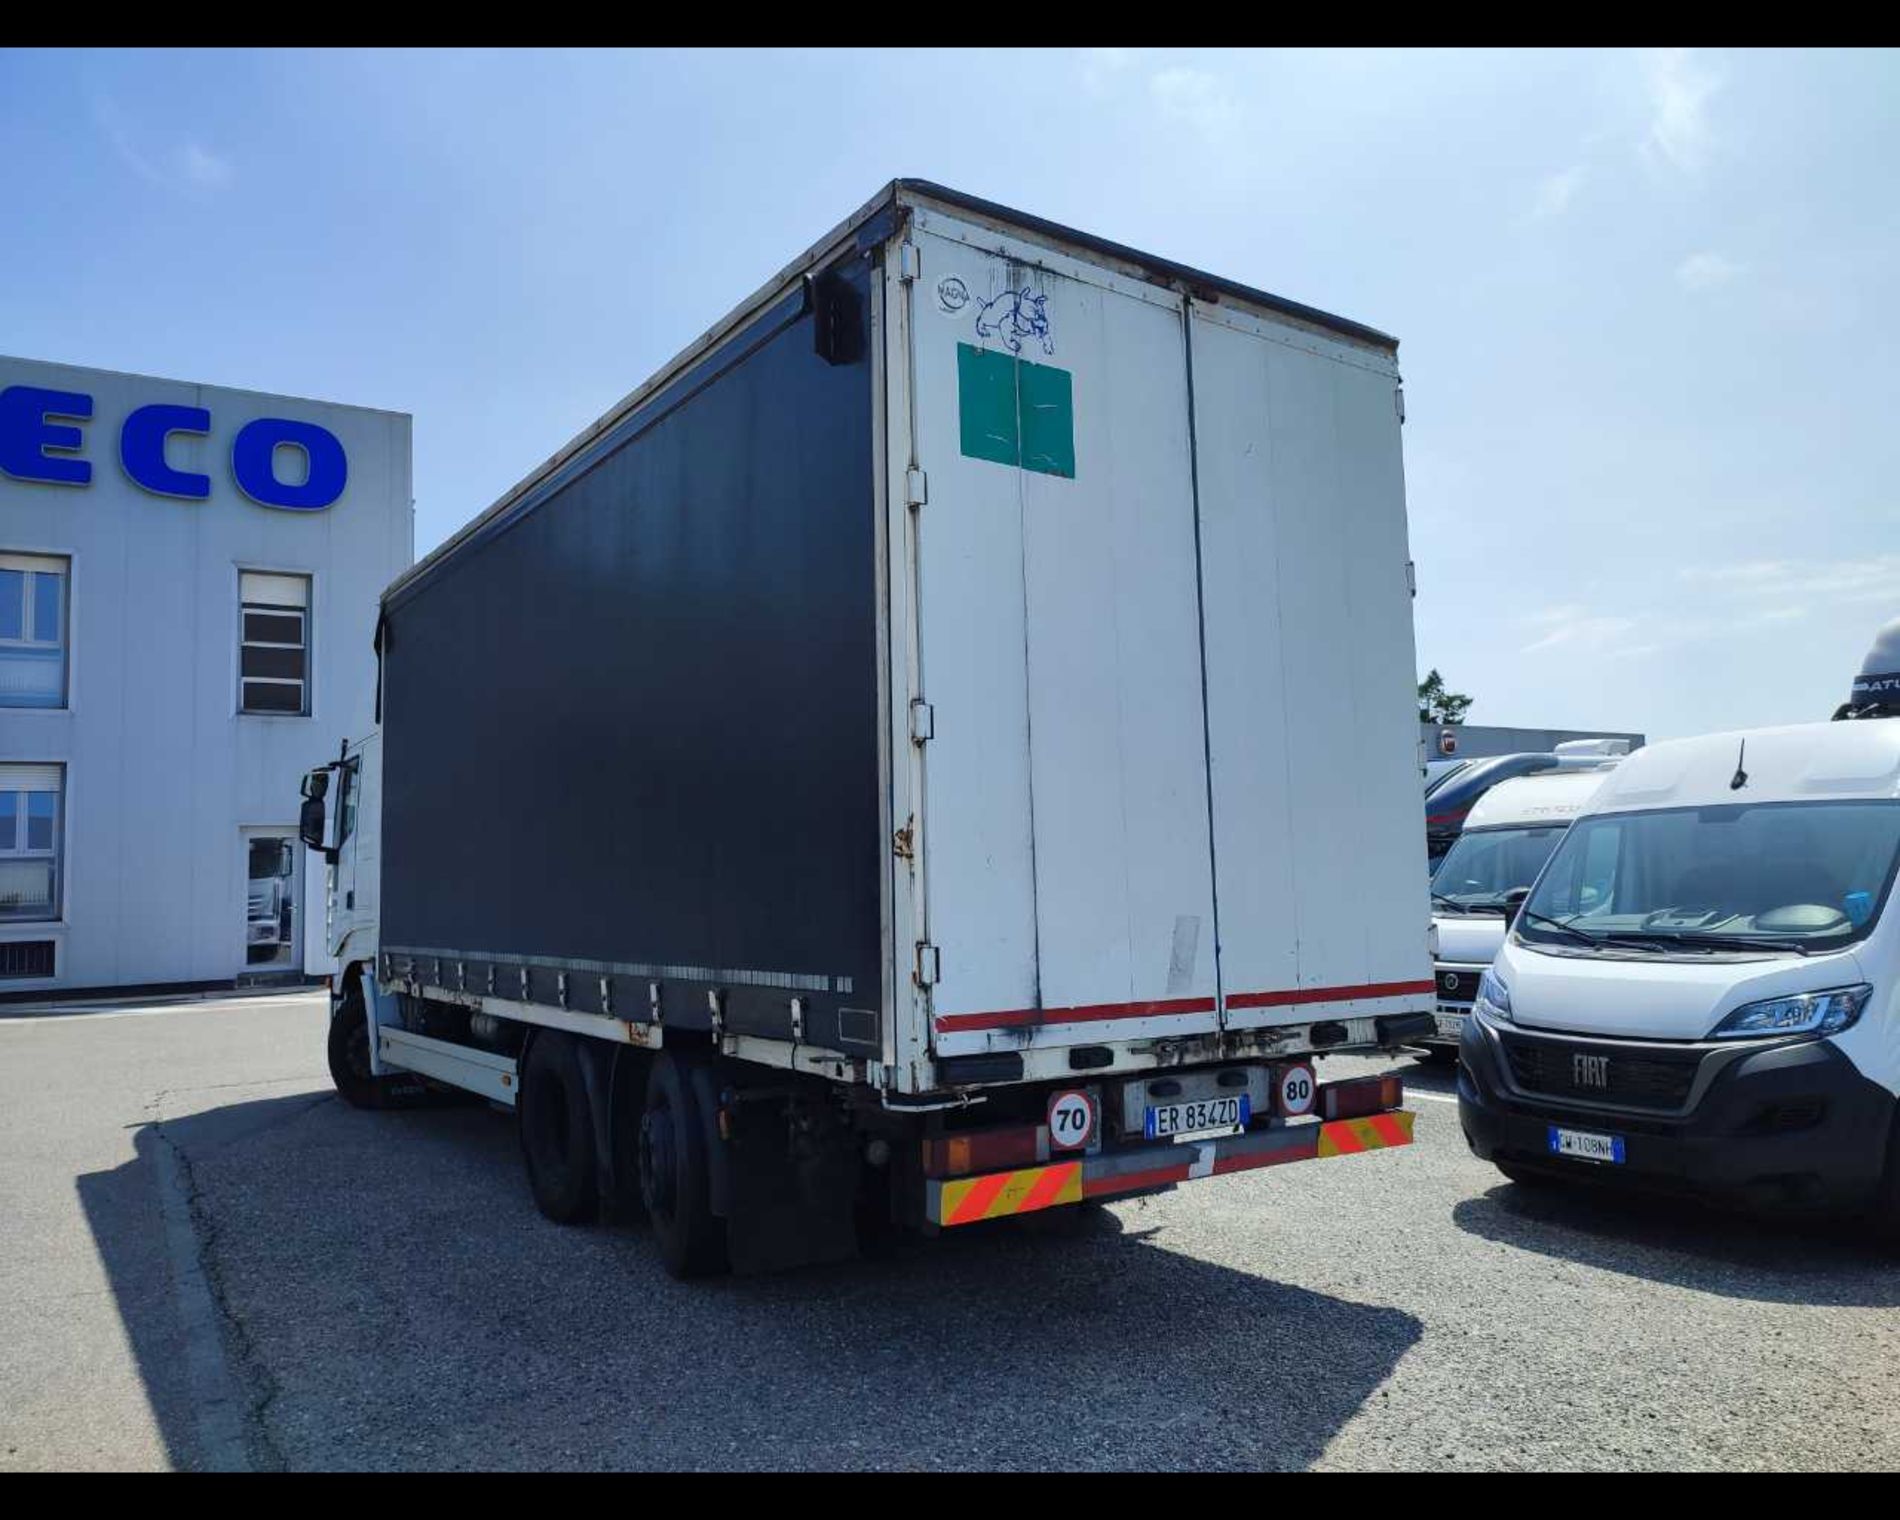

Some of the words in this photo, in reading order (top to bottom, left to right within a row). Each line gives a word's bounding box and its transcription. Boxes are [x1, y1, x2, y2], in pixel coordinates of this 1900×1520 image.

[0, 385, 347, 511] ECO
[1573, 1053, 1609, 1088] FIAT
[1286, 1079, 1309, 1101] 80
[1057, 1108, 1085, 1132] 70
[1158, 1109, 1180, 1132] ER
[1186, 1098, 1238, 1128] 834ZD
